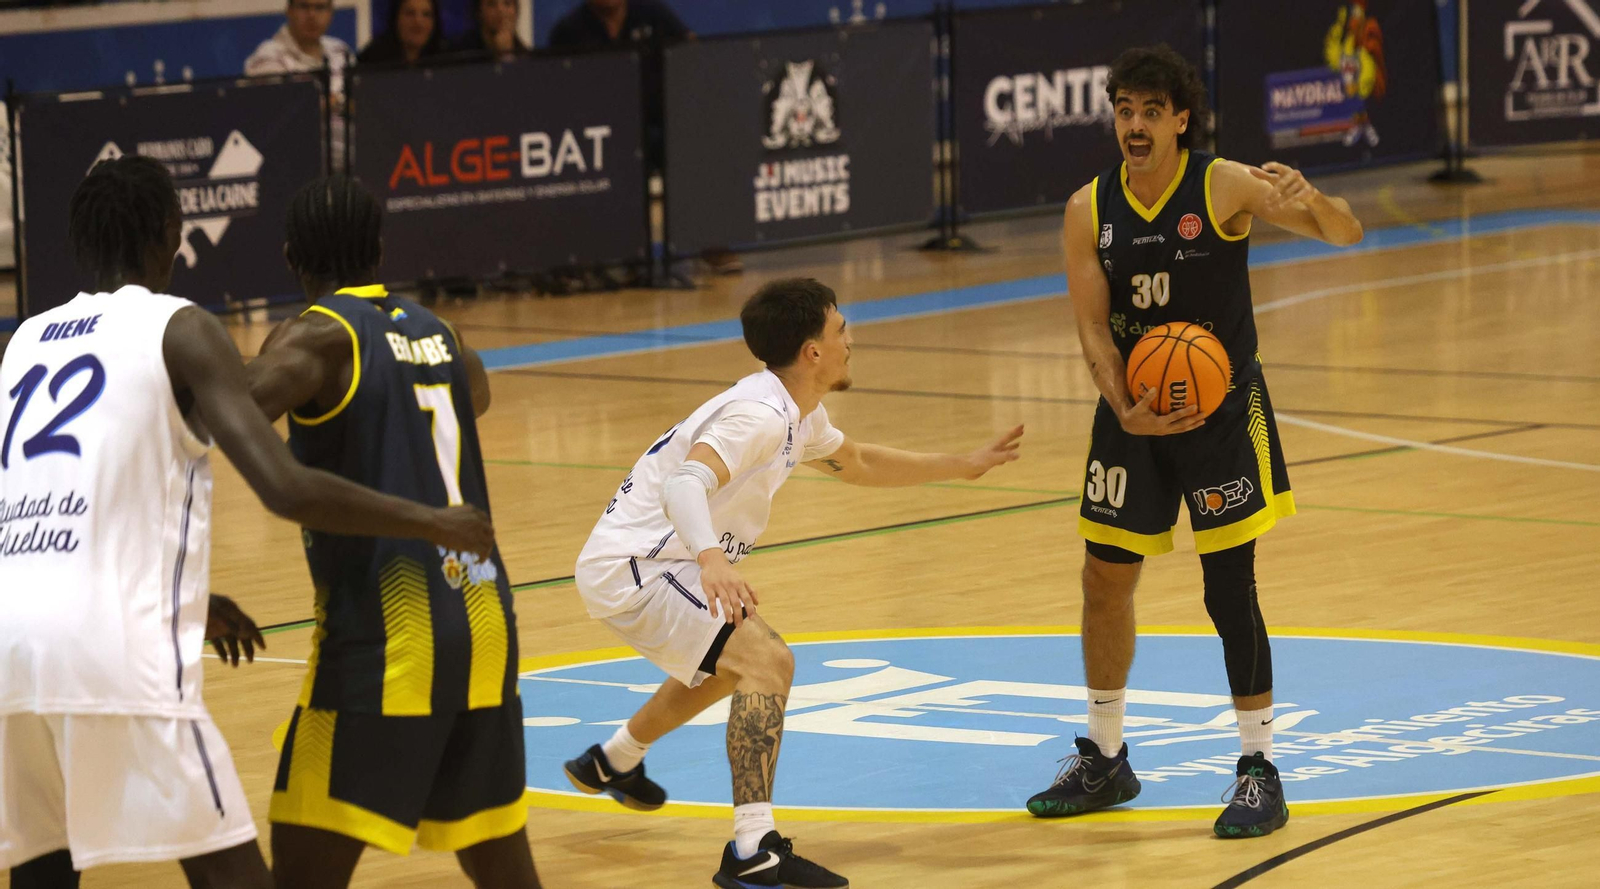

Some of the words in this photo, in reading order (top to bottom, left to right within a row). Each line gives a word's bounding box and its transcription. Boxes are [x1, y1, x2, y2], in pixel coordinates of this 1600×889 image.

[983, 65, 1115, 124] CENTR
[1269, 80, 1345, 109] MAYORAL
[388, 125, 611, 190] ALGE-BAT
[783, 154, 850, 187] MUSIC
[755, 182, 850, 223] EVENTS
[1131, 271, 1170, 310] 30
[39, 313, 103, 342] DIENE
[1, 353, 107, 470] 12
[59, 489, 88, 516] de
[1087, 459, 1128, 509] 30
